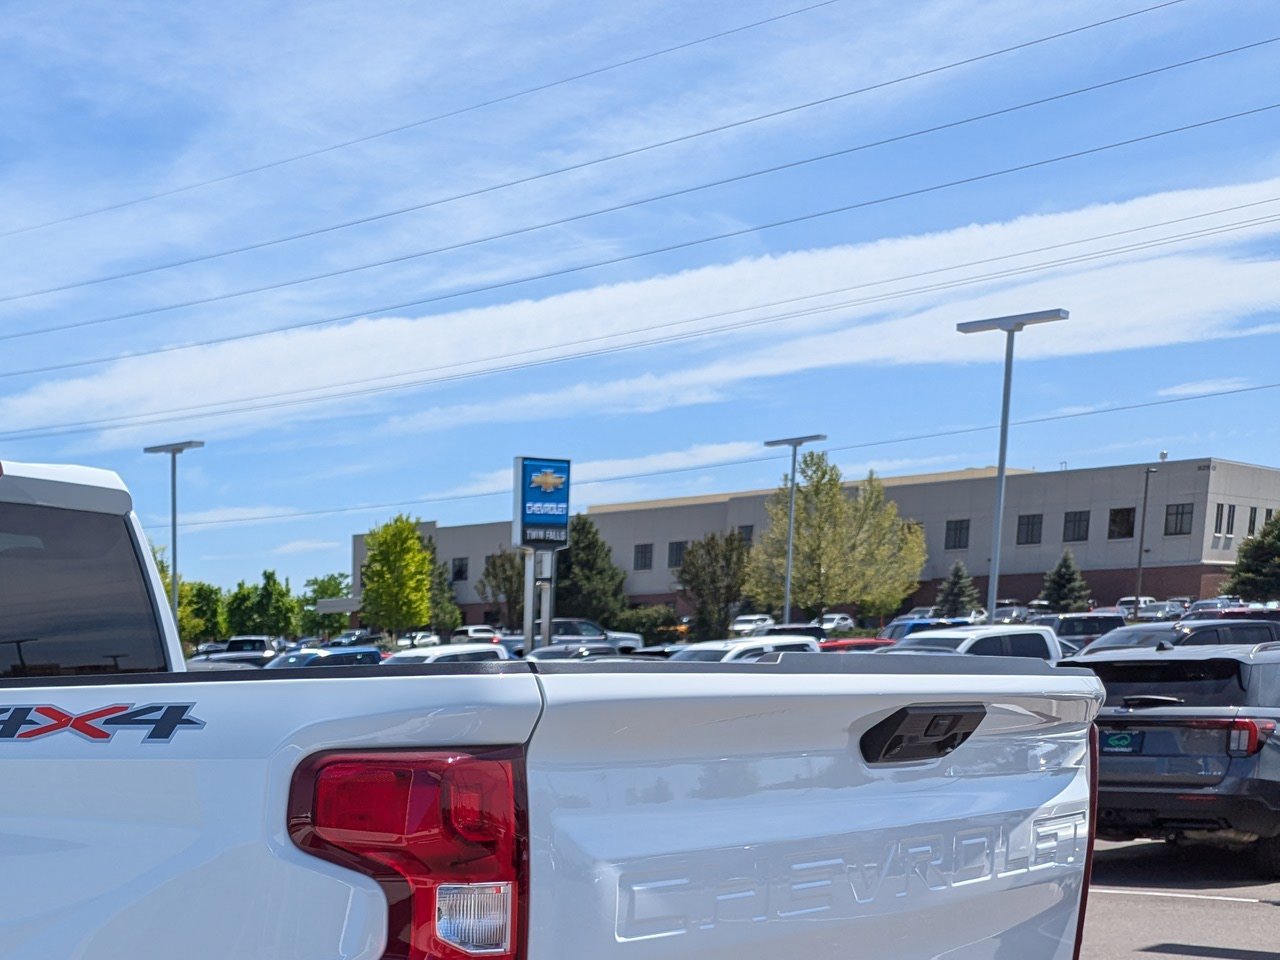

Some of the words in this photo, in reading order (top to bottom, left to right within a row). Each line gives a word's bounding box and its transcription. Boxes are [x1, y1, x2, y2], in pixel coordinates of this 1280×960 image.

[526, 502, 568, 515] CHEVROLET
[526, 529, 544, 540] TWIN
[545, 530, 566, 541] FALLS
[615, 809, 1087, 943] CHEVROLET
